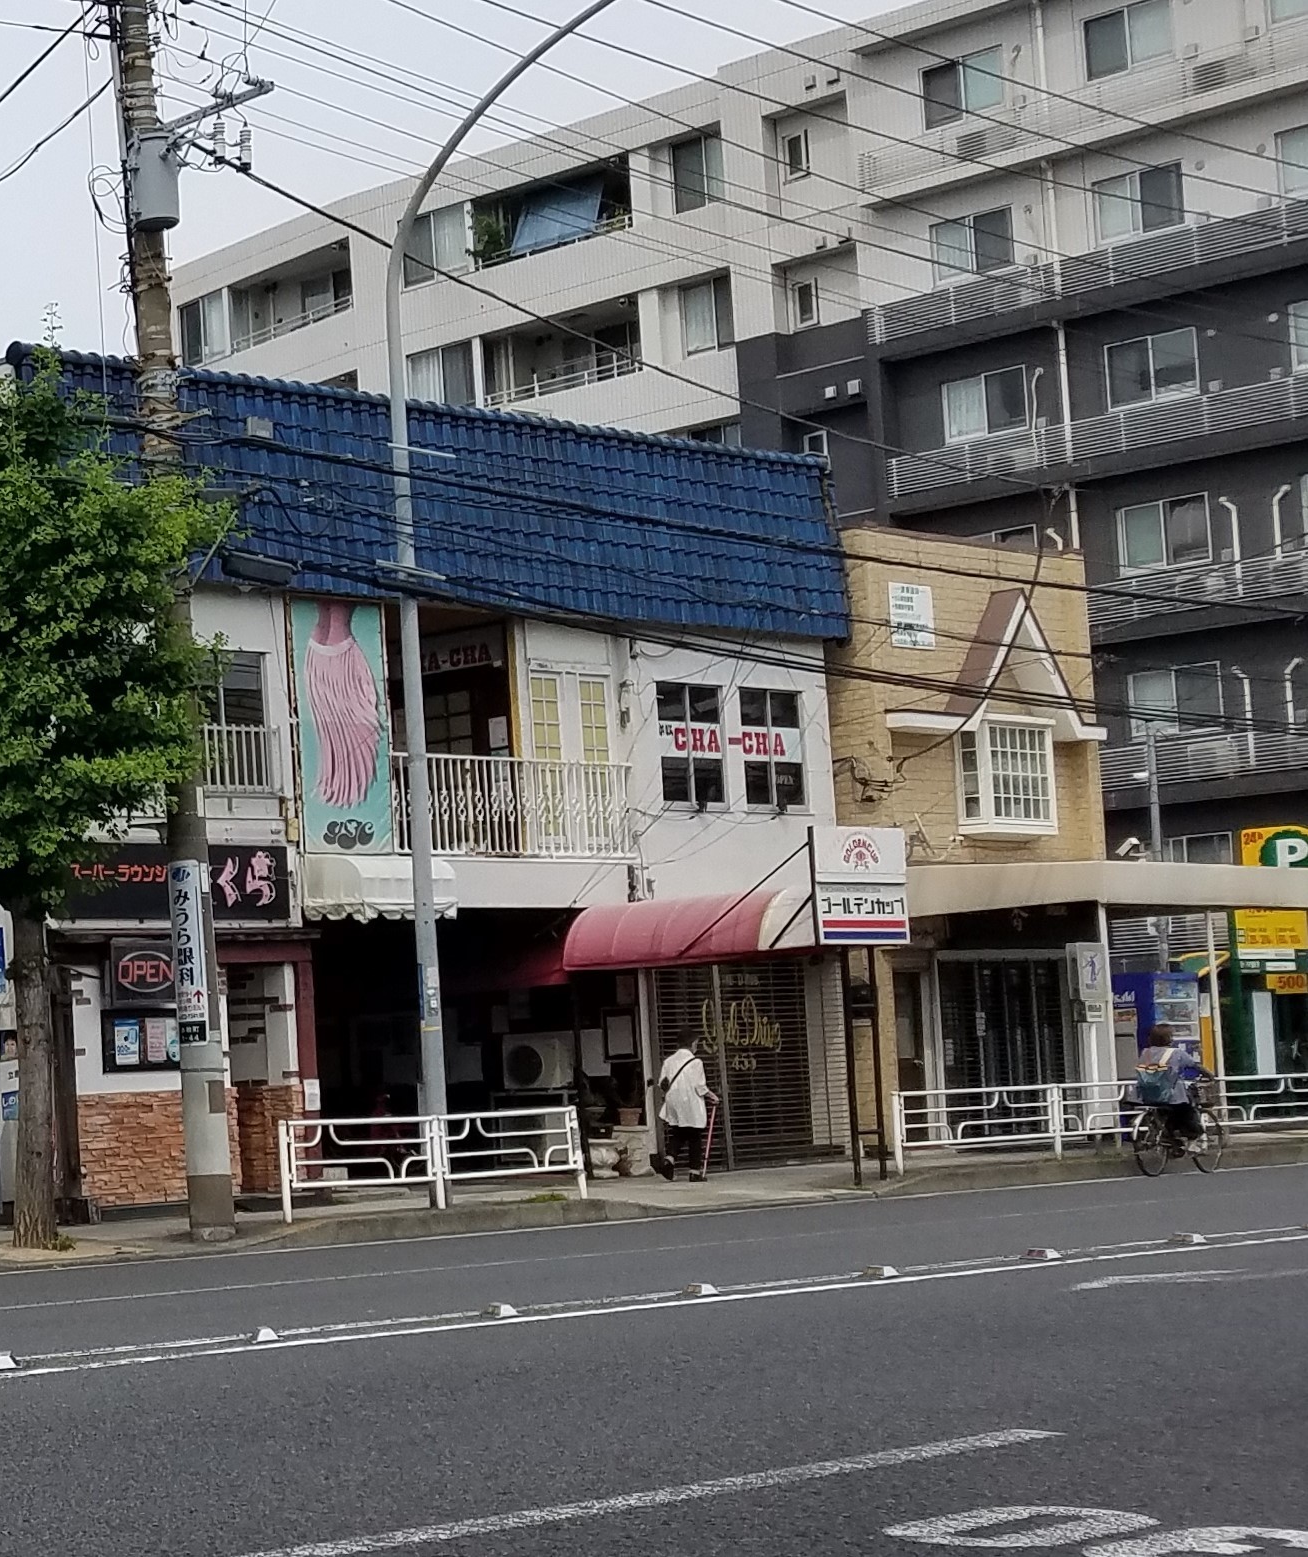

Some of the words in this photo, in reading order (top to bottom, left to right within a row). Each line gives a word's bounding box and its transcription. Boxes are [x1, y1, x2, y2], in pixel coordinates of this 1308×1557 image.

[674, 727, 786, 757] CHA-CHA
[1275, 838, 1308, 868] P
[173, 888, 195, 987] みうら眼科
[118, 960, 174, 984] OPEN
